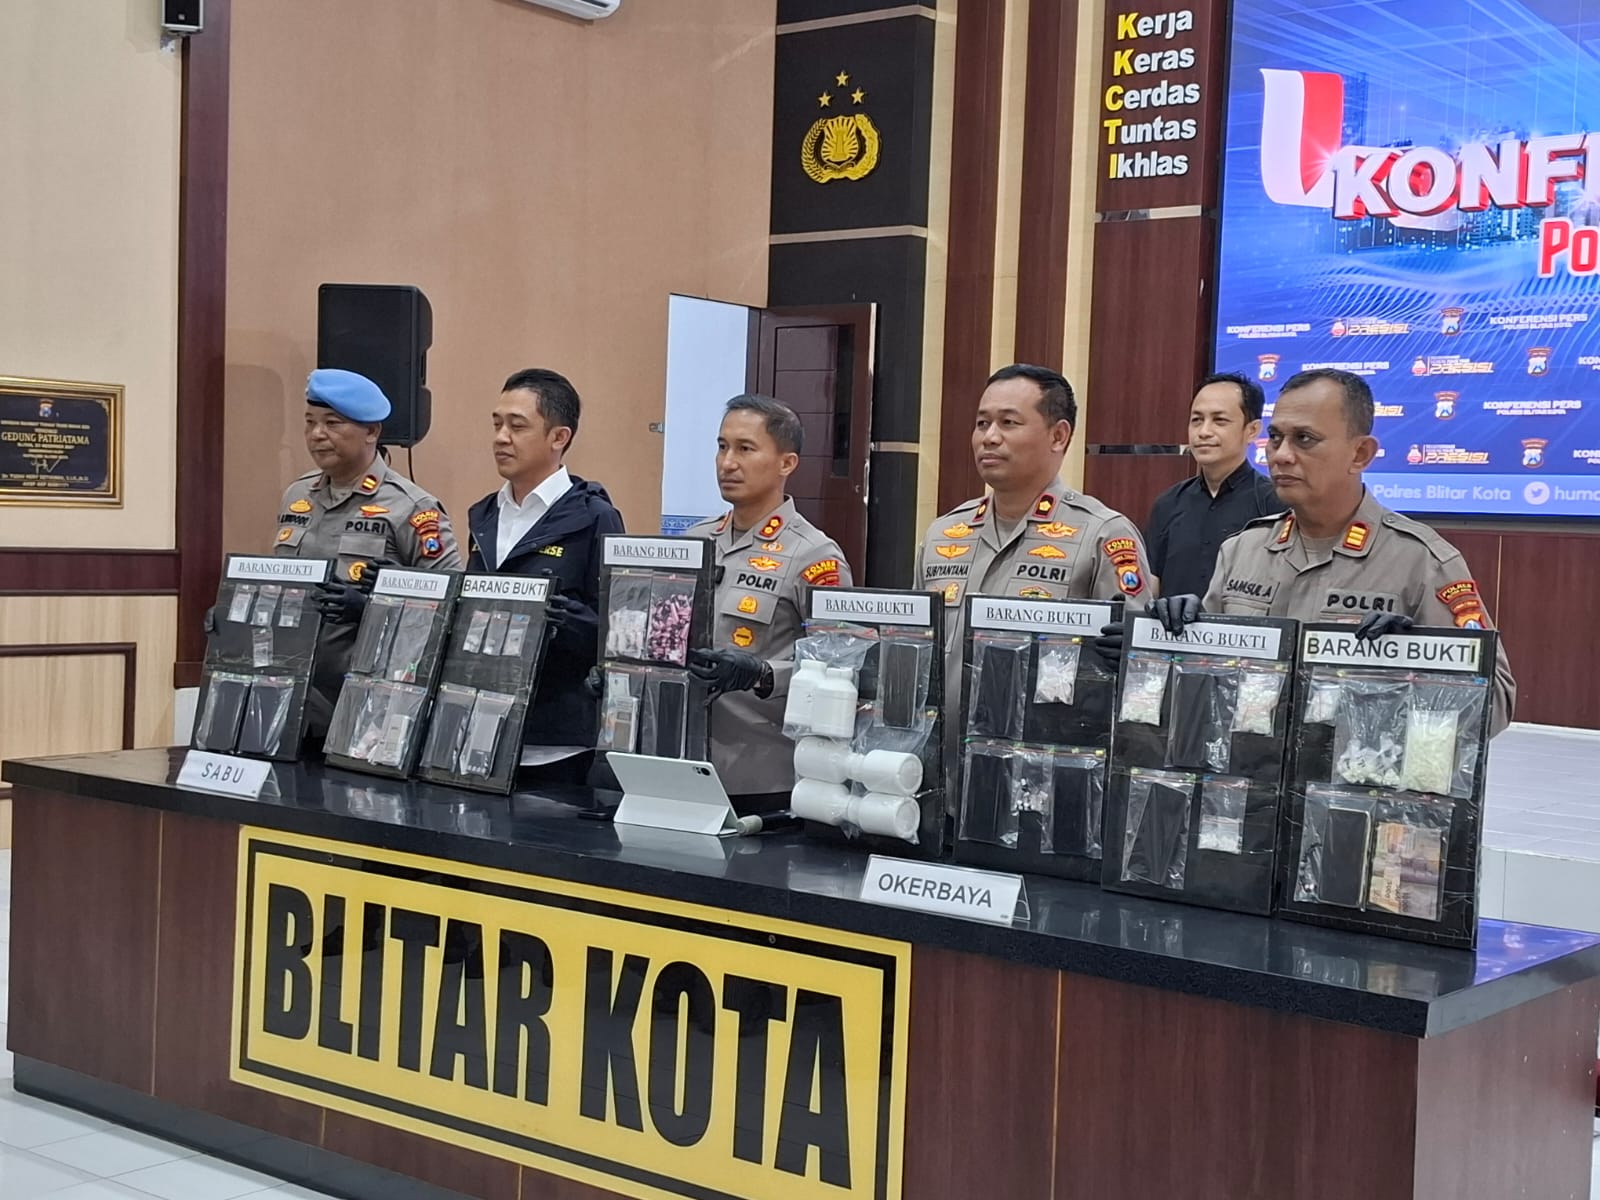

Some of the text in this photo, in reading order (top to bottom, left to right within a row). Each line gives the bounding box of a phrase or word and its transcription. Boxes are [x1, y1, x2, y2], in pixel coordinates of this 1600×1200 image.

[1117, 10, 1193, 40] Kerja
[1113, 47, 1195, 76] Keras
[1105, 80, 1200, 111] Cerdas
[1103, 115, 1197, 145] Tuntas
[1109, 151, 1189, 179] Ikhlas
[1332, 132, 1600, 220] KONF
[1490, 313, 1588, 324] KONFERENSI PERS
[1483, 400, 1582, 410] KONFERENSI PERS
[1, 432, 90, 445] GEDUNG PATRIATAMA
[1373, 484, 1512, 501] Polres Blitar Kota
[345, 521, 386, 534] POLRI
[613, 545, 690, 560] BARANG BUKTI
[238, 562, 313, 576] BARANG BUKTI
[1016, 565, 1067, 582] POLRI
[381, 576, 438, 592] BARANG BUKTI
[463, 580, 548, 596] BARANG BUKTI
[736, 572, 778, 592] POLRI
[825, 599, 915, 615] BARANG BUKTI
[1326, 593, 1394, 612] POLRI
[986, 606, 1092, 625] BARANG BUKTI
[1218, 632, 1267, 649] BUKTI
[1307, 637, 1476, 664] BARANG BUKTI
[201, 762, 245, 784] SABU
[878, 873, 992, 908] OKERBAYA
[262, 882, 853, 1191] BLITAR KOTA
